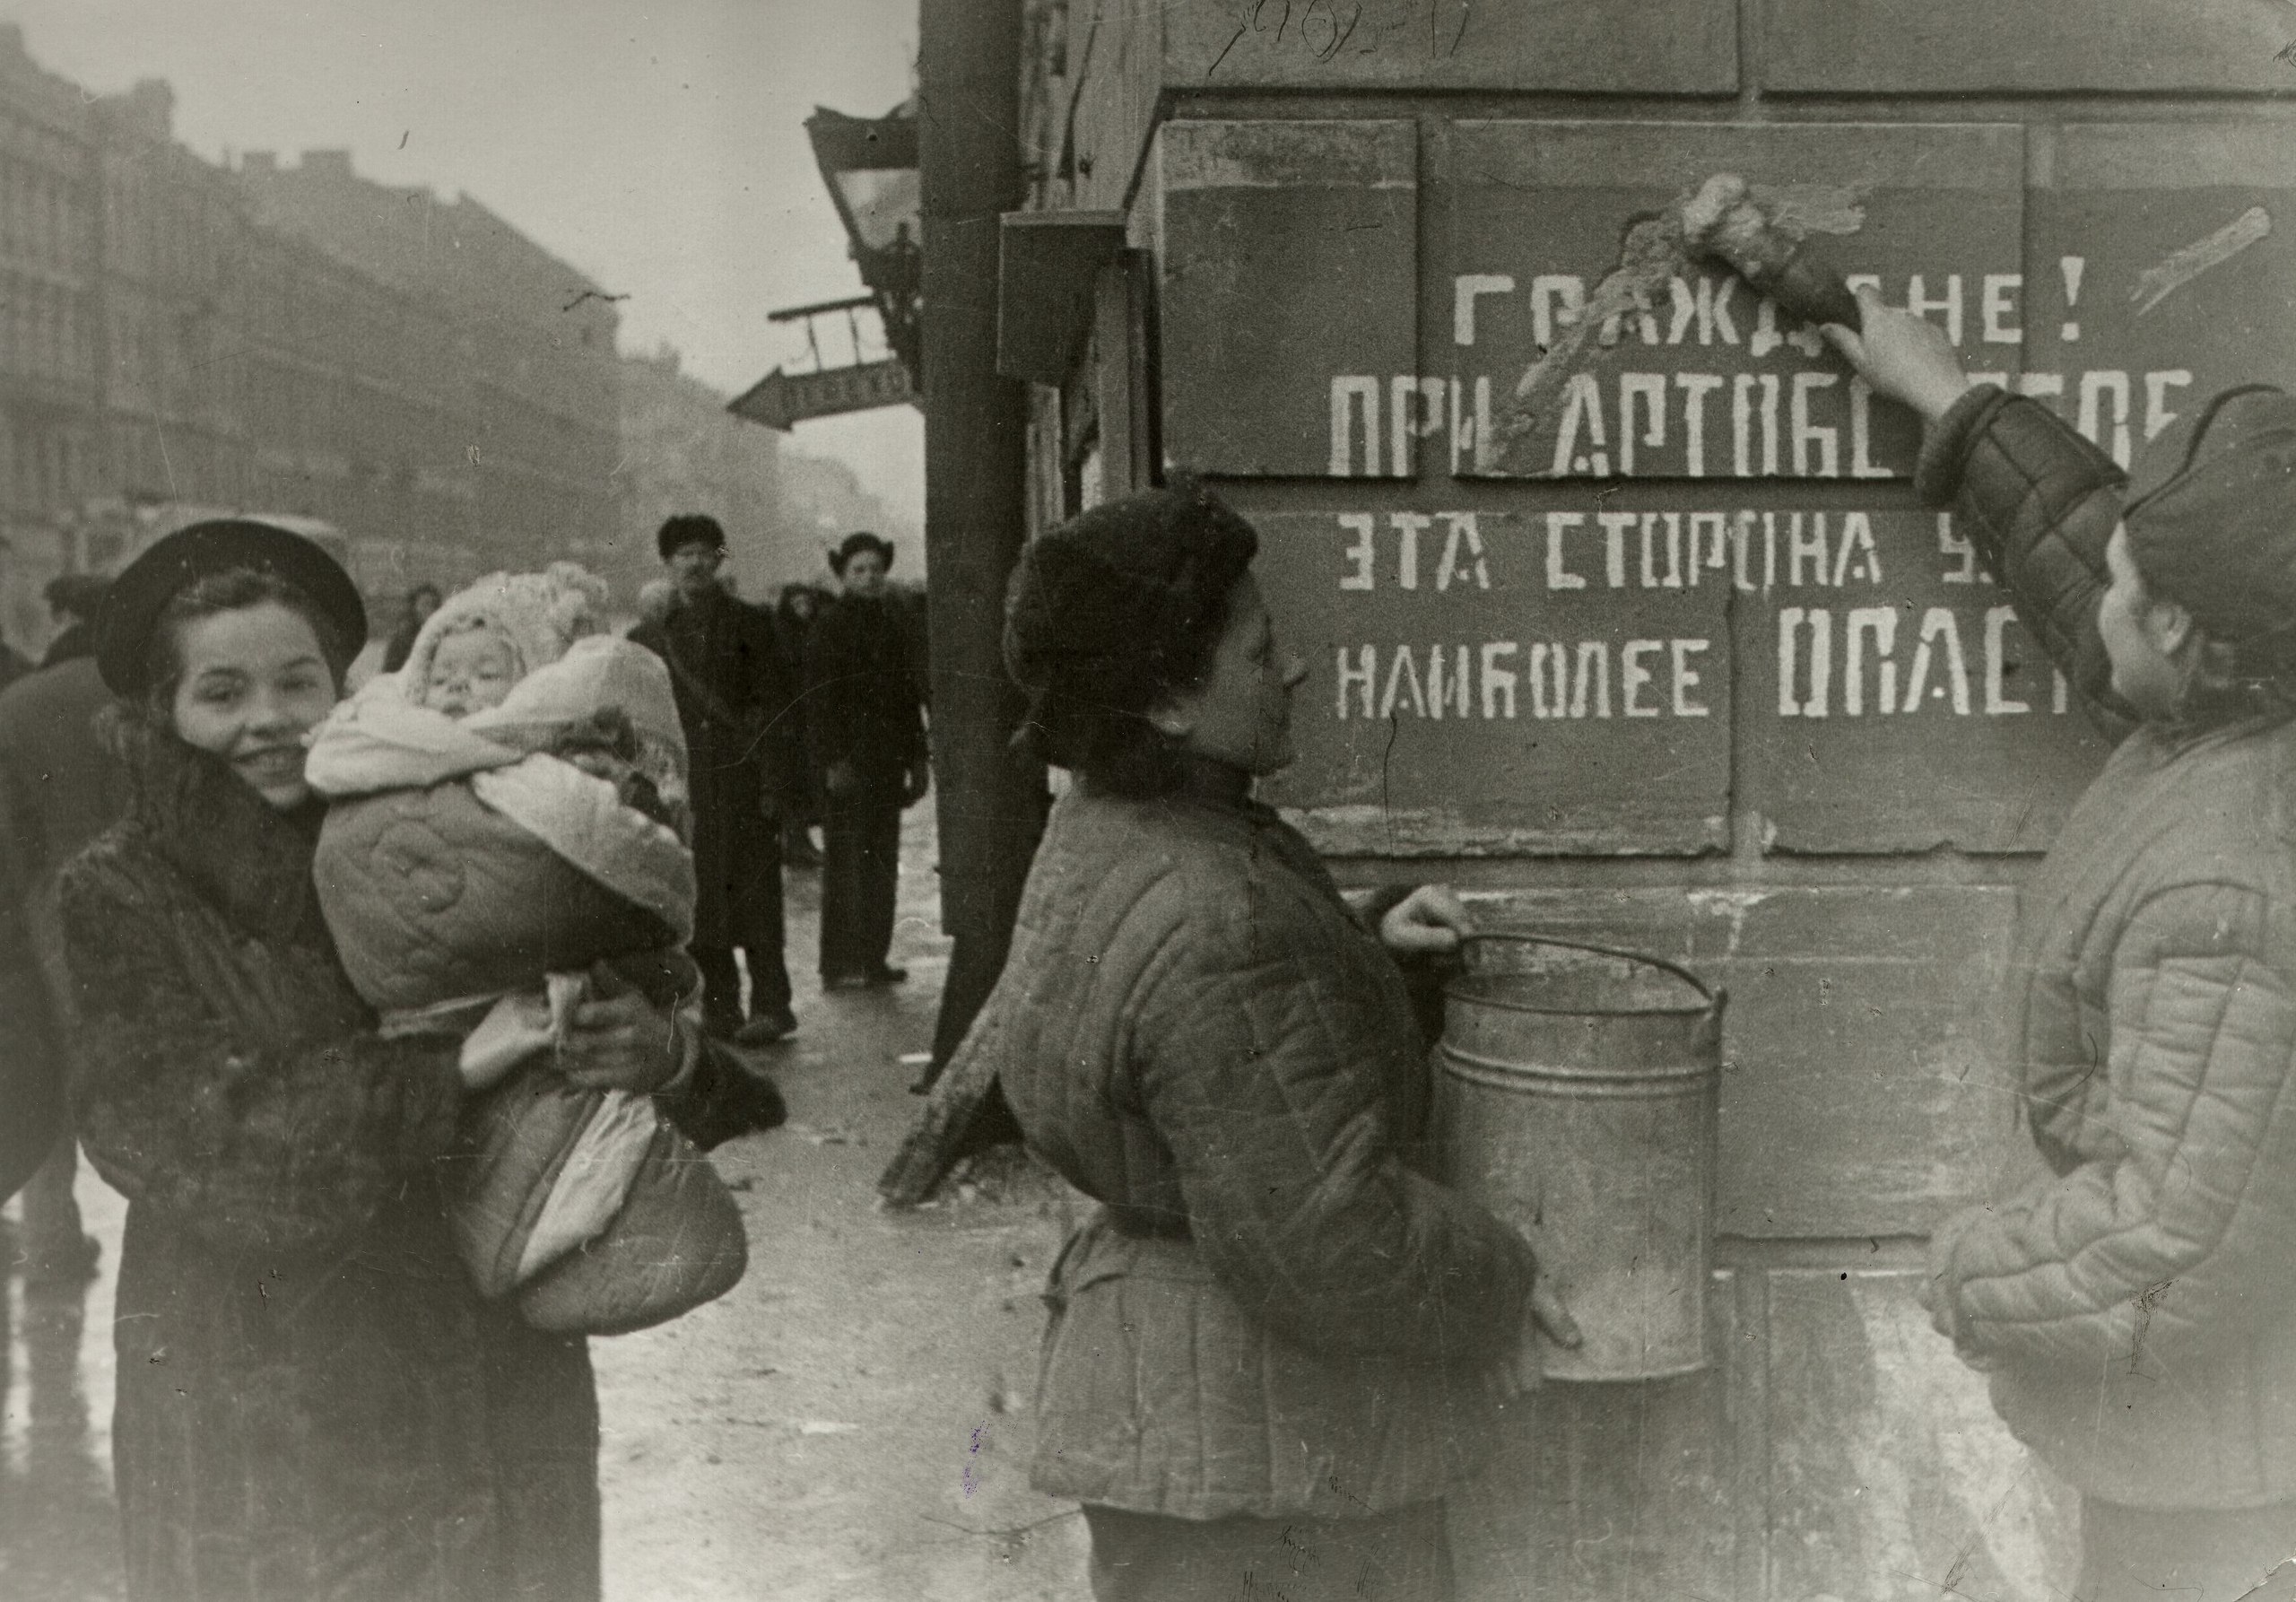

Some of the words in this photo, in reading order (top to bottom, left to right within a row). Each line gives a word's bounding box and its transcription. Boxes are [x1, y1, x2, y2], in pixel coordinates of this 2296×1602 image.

[1453, 256, 2085, 357] ГРАЖДНЕ!
[1328, 374, 1492, 477] ПРИ
[1552, 369, 2194, 477] АРТОБСЛЕ
[1338, 511, 1490, 590] ЭТА
[1546, 509, 1881, 591] СТОРОНА
[1337, 638, 1709, 718] НАИБОЛЕЕ
[1778, 605, 2067, 717] ОПАС
